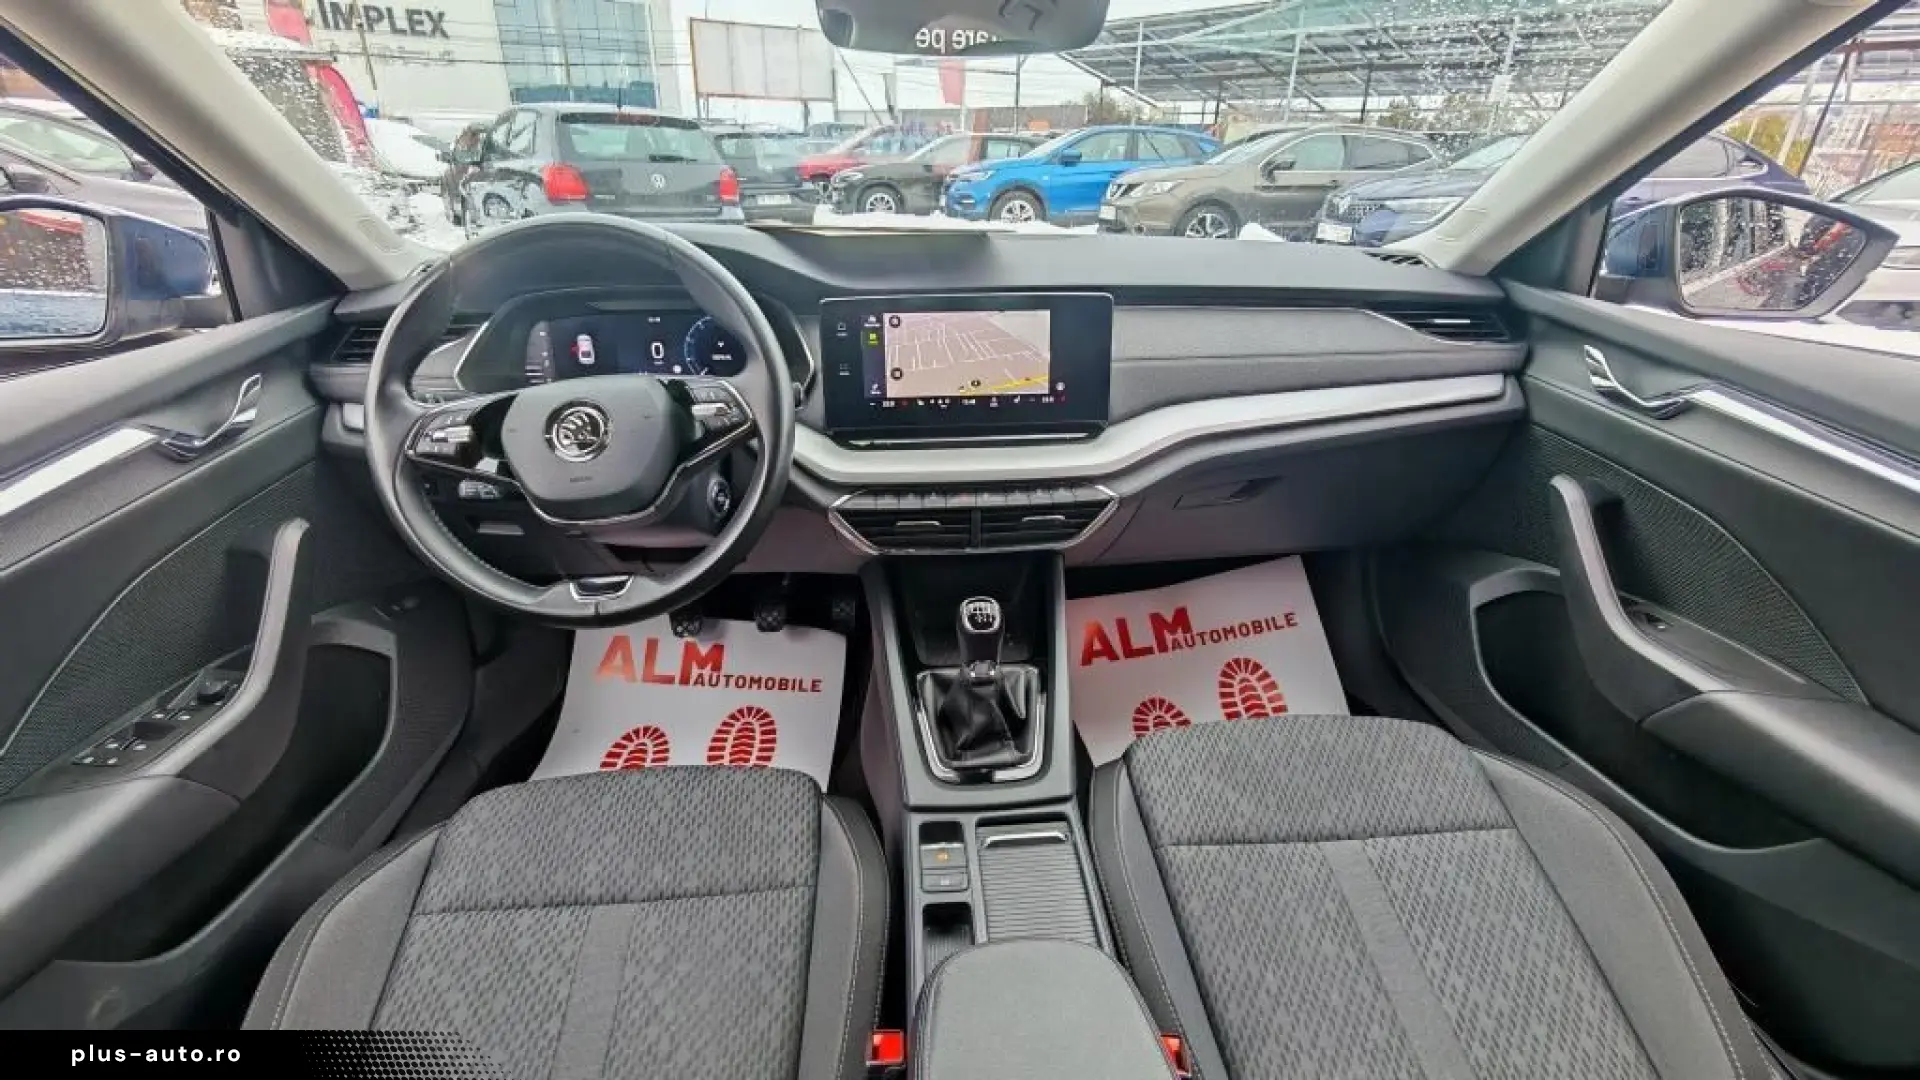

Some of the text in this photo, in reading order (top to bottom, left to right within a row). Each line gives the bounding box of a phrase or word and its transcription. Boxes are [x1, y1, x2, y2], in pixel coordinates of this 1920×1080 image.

[594, 634, 823, 693] ALM AUTOMOBILE
[1080, 605, 1299, 667] ALM AUTOMOBILE
